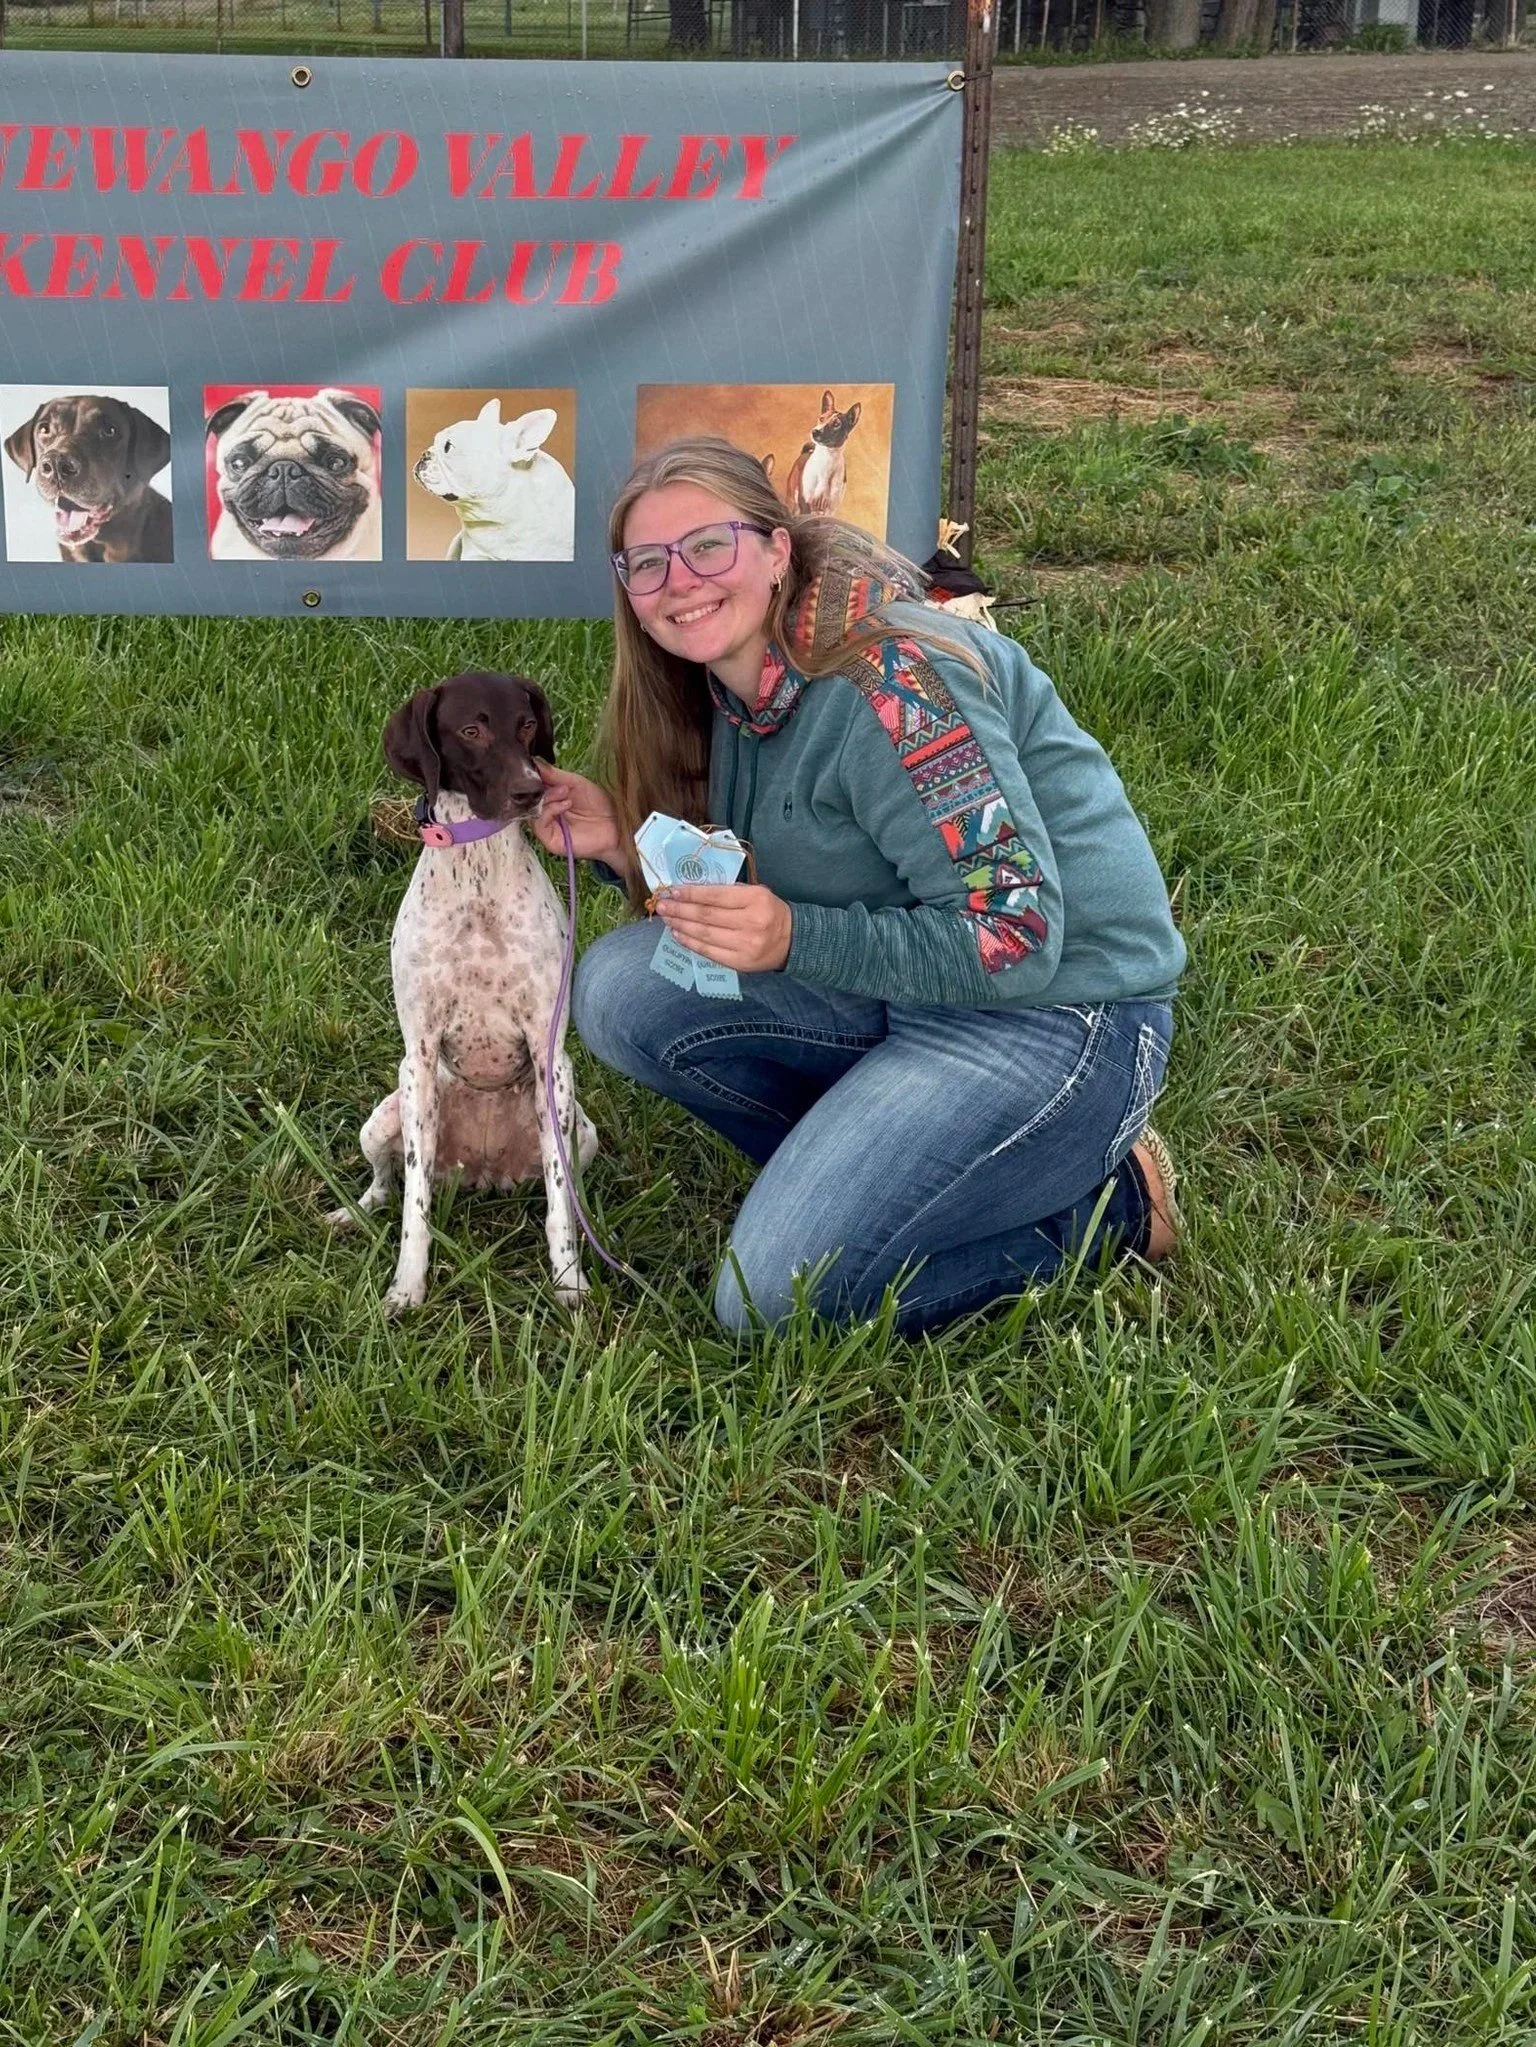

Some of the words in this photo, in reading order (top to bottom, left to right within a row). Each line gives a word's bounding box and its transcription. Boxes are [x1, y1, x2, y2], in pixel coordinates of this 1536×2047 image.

[443, 131, 799, 200] VALLEY
[0, 232, 356, 304] KENNEL
[380, 237, 624, 306] CLUB
